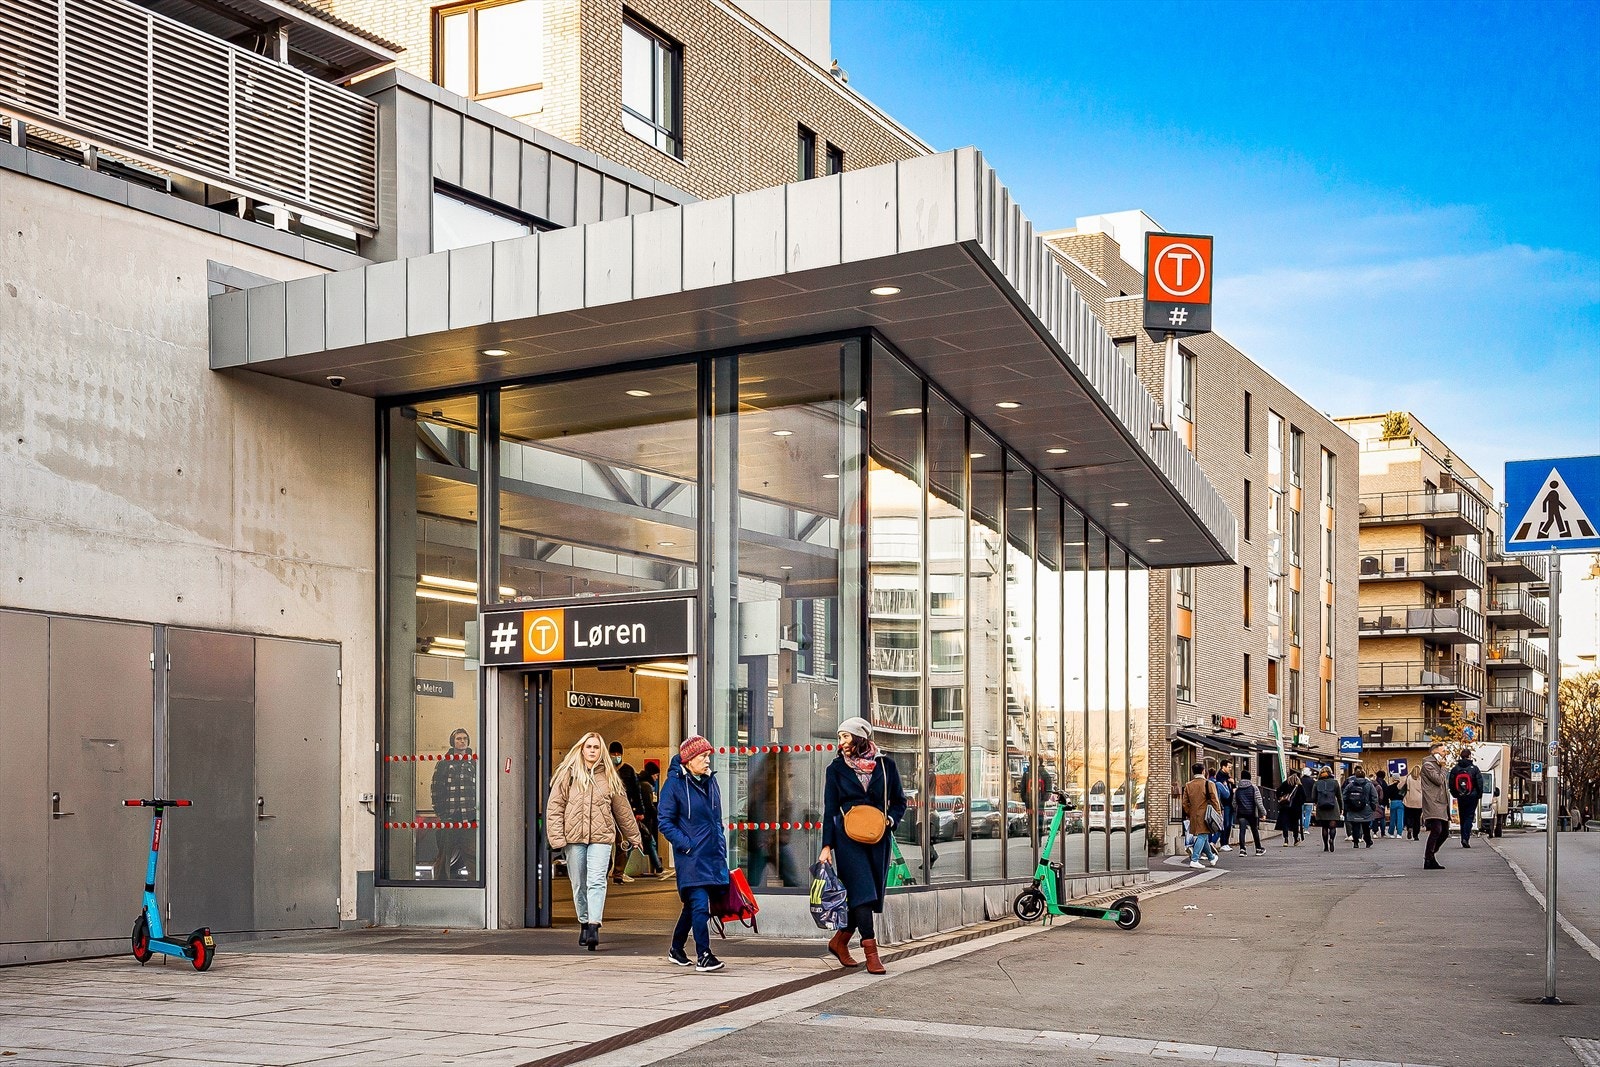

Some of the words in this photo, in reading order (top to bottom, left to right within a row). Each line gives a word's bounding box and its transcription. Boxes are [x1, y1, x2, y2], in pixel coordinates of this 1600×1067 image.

[573, 620, 646, 648] Løren
[422, 684, 443, 694] Metro
[594, 697, 614, 708] T-bane
[614, 699, 631, 709] Metro
[1397, 762, 1407, 774] P
[1533, 763, 1540, 772] P
